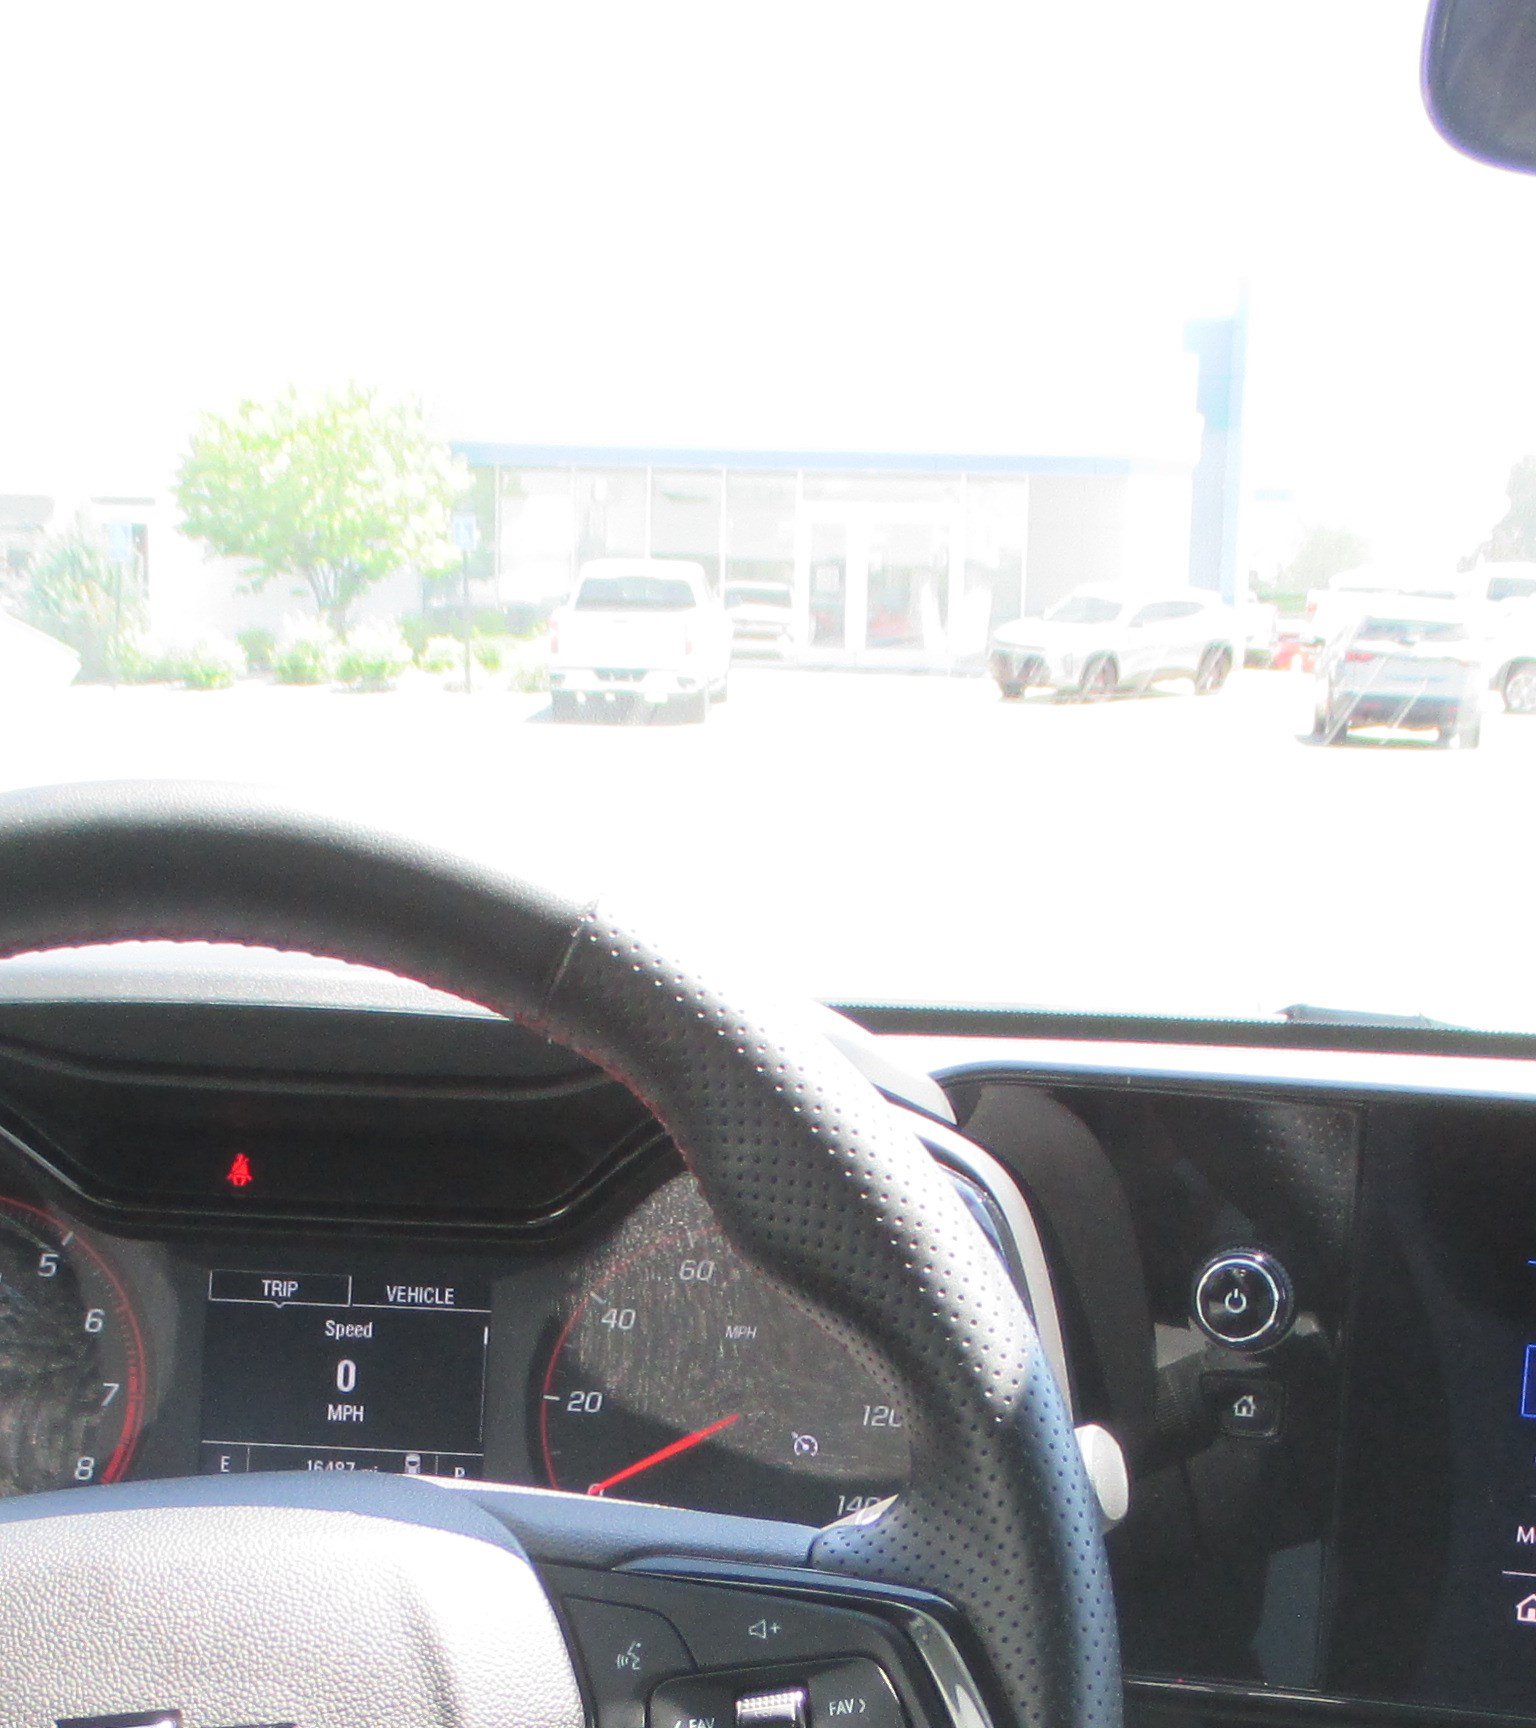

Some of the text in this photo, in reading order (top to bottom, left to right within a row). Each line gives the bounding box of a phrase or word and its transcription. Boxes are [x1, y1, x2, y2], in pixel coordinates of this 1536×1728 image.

[38, 1252, 59, 1277] 5
[679, 1259, 715, 1282] 60
[261, 1279, 299, 1298] TRIP
[386, 1284, 455, 1306] VEHICLE
[84, 1309, 104, 1334] 6
[325, 1320, 373, 1341] Speed
[600, 1308, 637, 1331] 40
[725, 1324, 757, 1340] MPH
[336, 1360, 356, 1393] 0
[102, 1383, 120, 1407] 7
[566, 1390, 603, 1413] 20
[327, 1403, 365, 1423] MPH
[74, 1457, 96, 1482] 8
[220, 1455, 230, 1473] E
[829, 1699, 855, 1716] FAV
